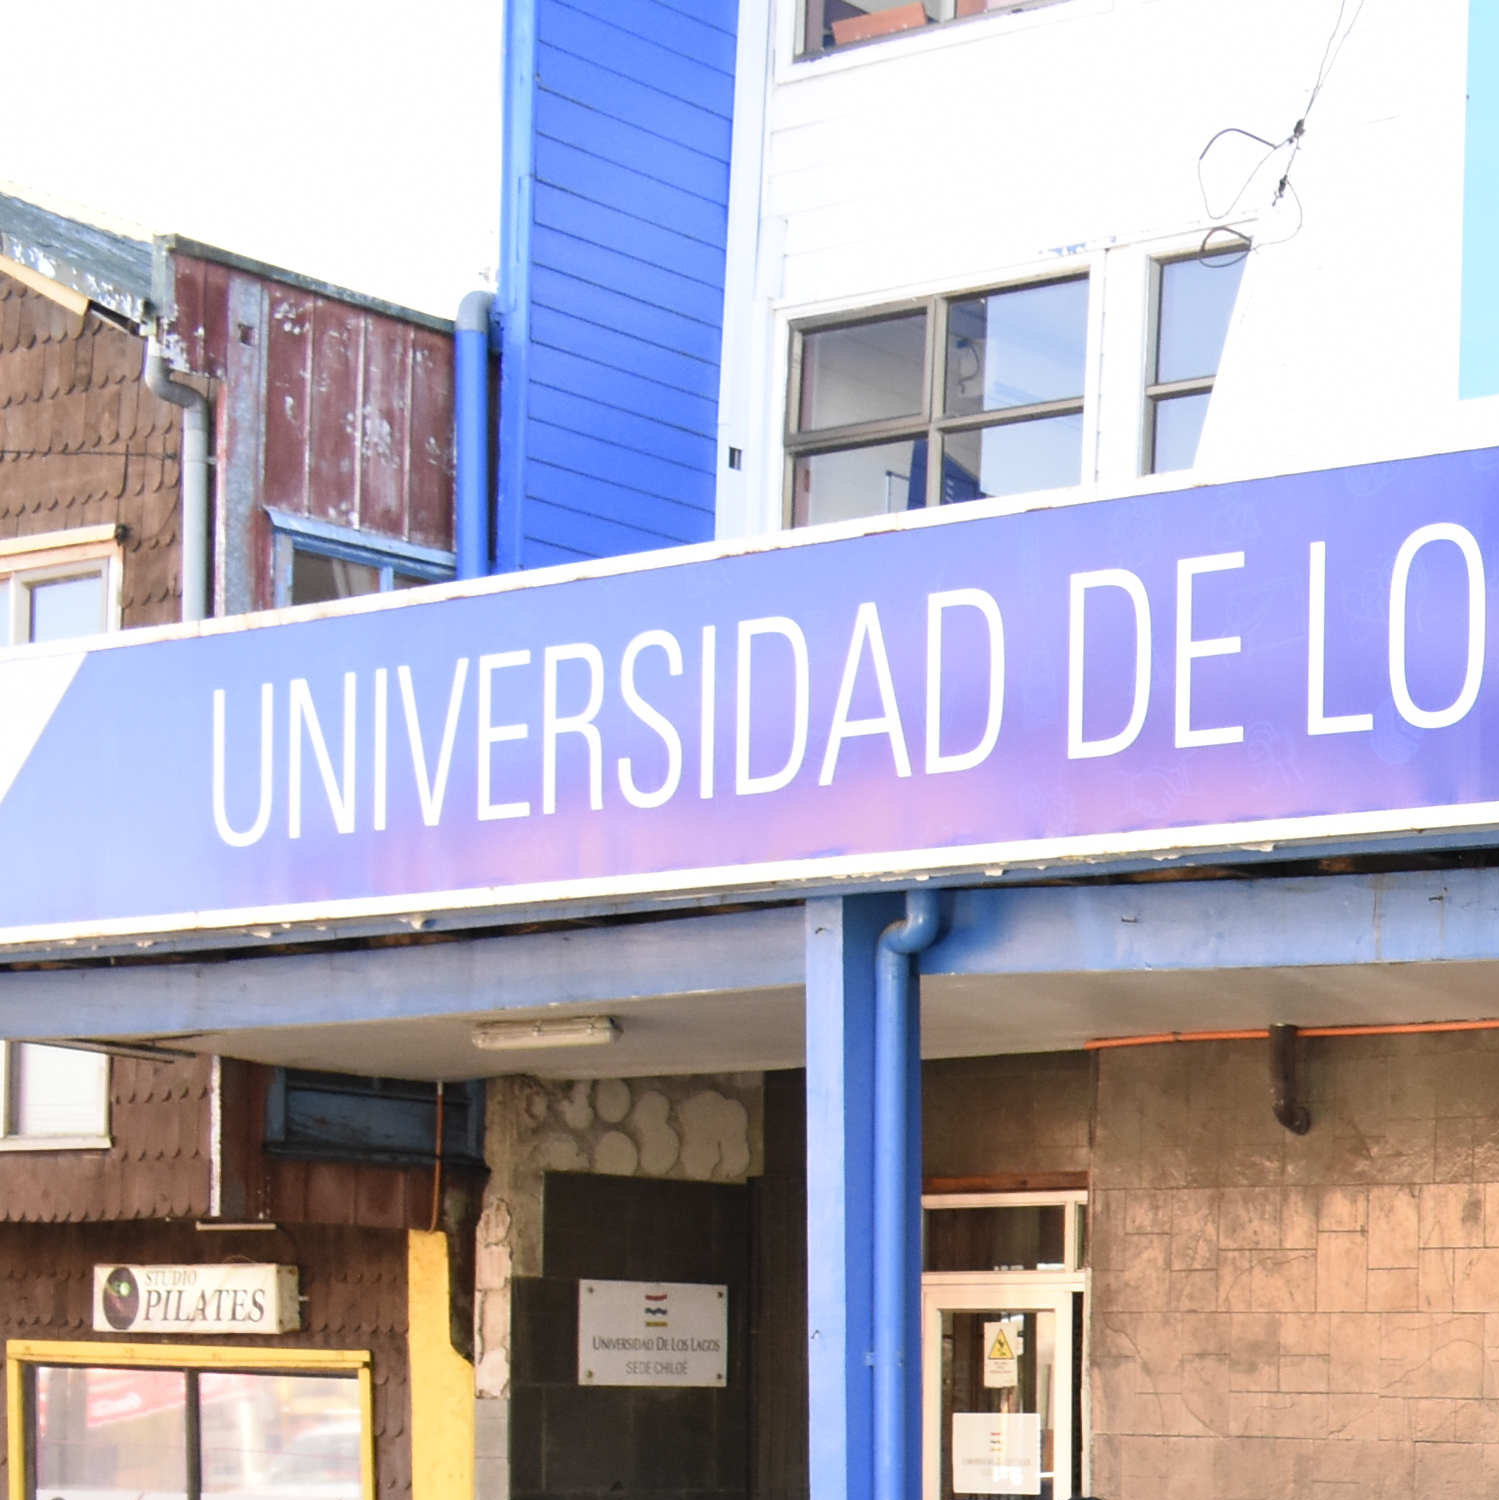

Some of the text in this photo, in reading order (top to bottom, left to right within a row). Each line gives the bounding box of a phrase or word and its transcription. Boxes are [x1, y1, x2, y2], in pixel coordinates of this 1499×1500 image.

[212, 587, 1005, 848] UNIVERSIDAD
[1067, 551, 1245, 760] DE
[144, 1269, 197, 1286] STUDIO
[143, 1288, 266, 1323] PILATES
[691, 1337, 720, 1351] LAGOS
[626, 1361, 651, 1374] SEDE
